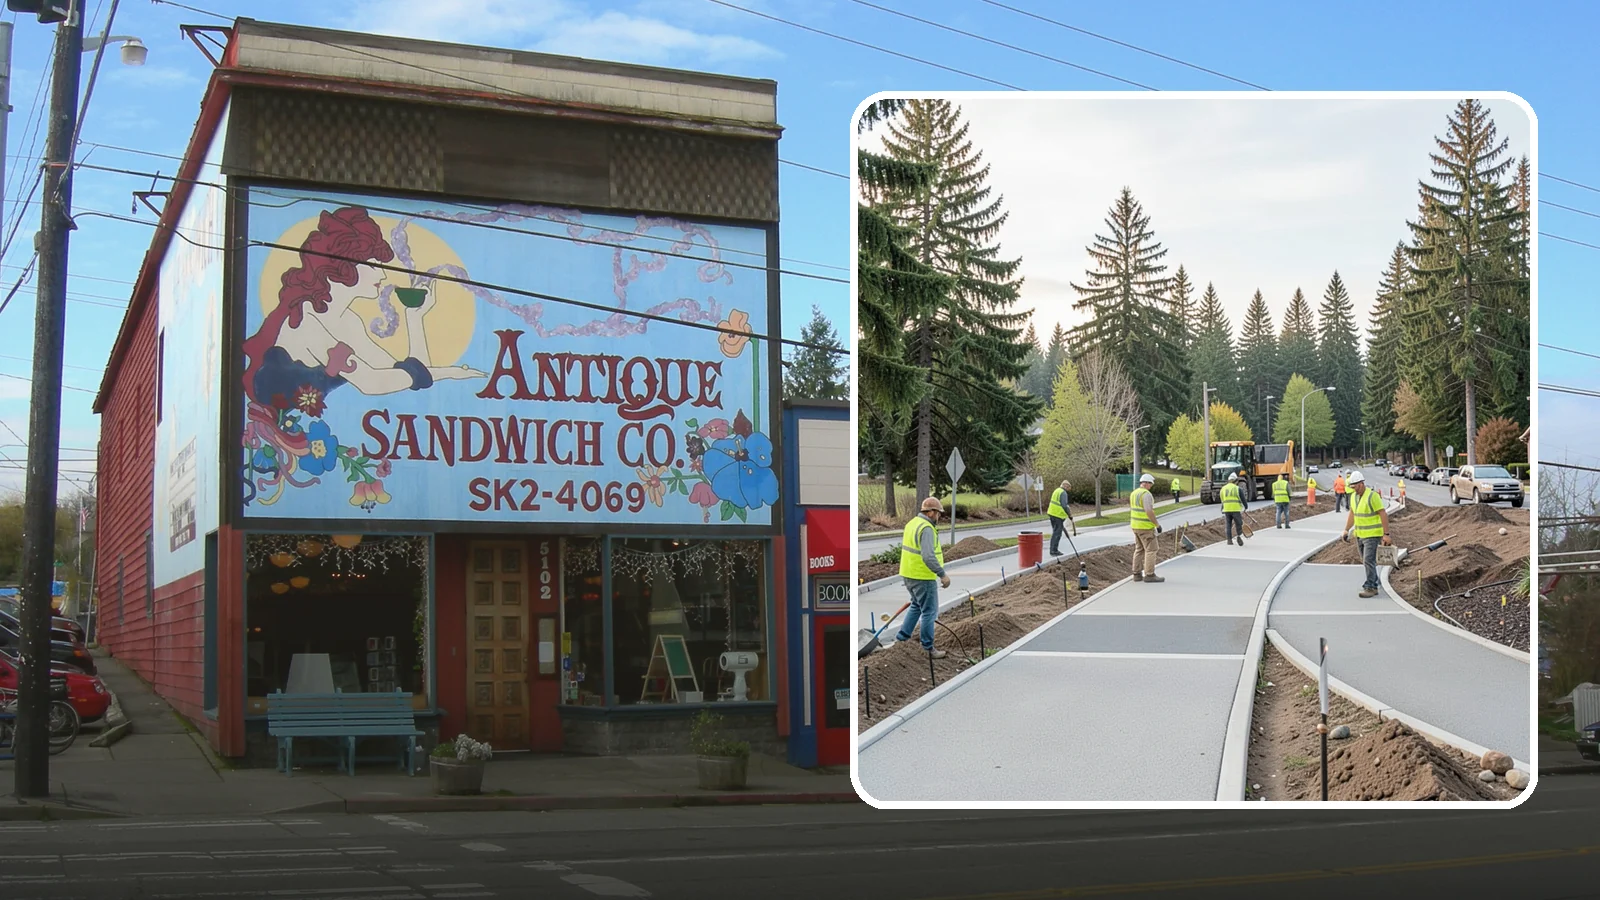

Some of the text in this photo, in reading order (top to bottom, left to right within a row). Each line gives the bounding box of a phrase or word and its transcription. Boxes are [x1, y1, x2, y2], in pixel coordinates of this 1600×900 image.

[476, 329, 723, 421] ANTIQUE
[361, 409, 685, 468] SANDWICH CO.
[469, 477, 646, 513] SK2-4069
[540, 542, 552, 600] 5102
[809, 555, 835, 569] BOOKS
